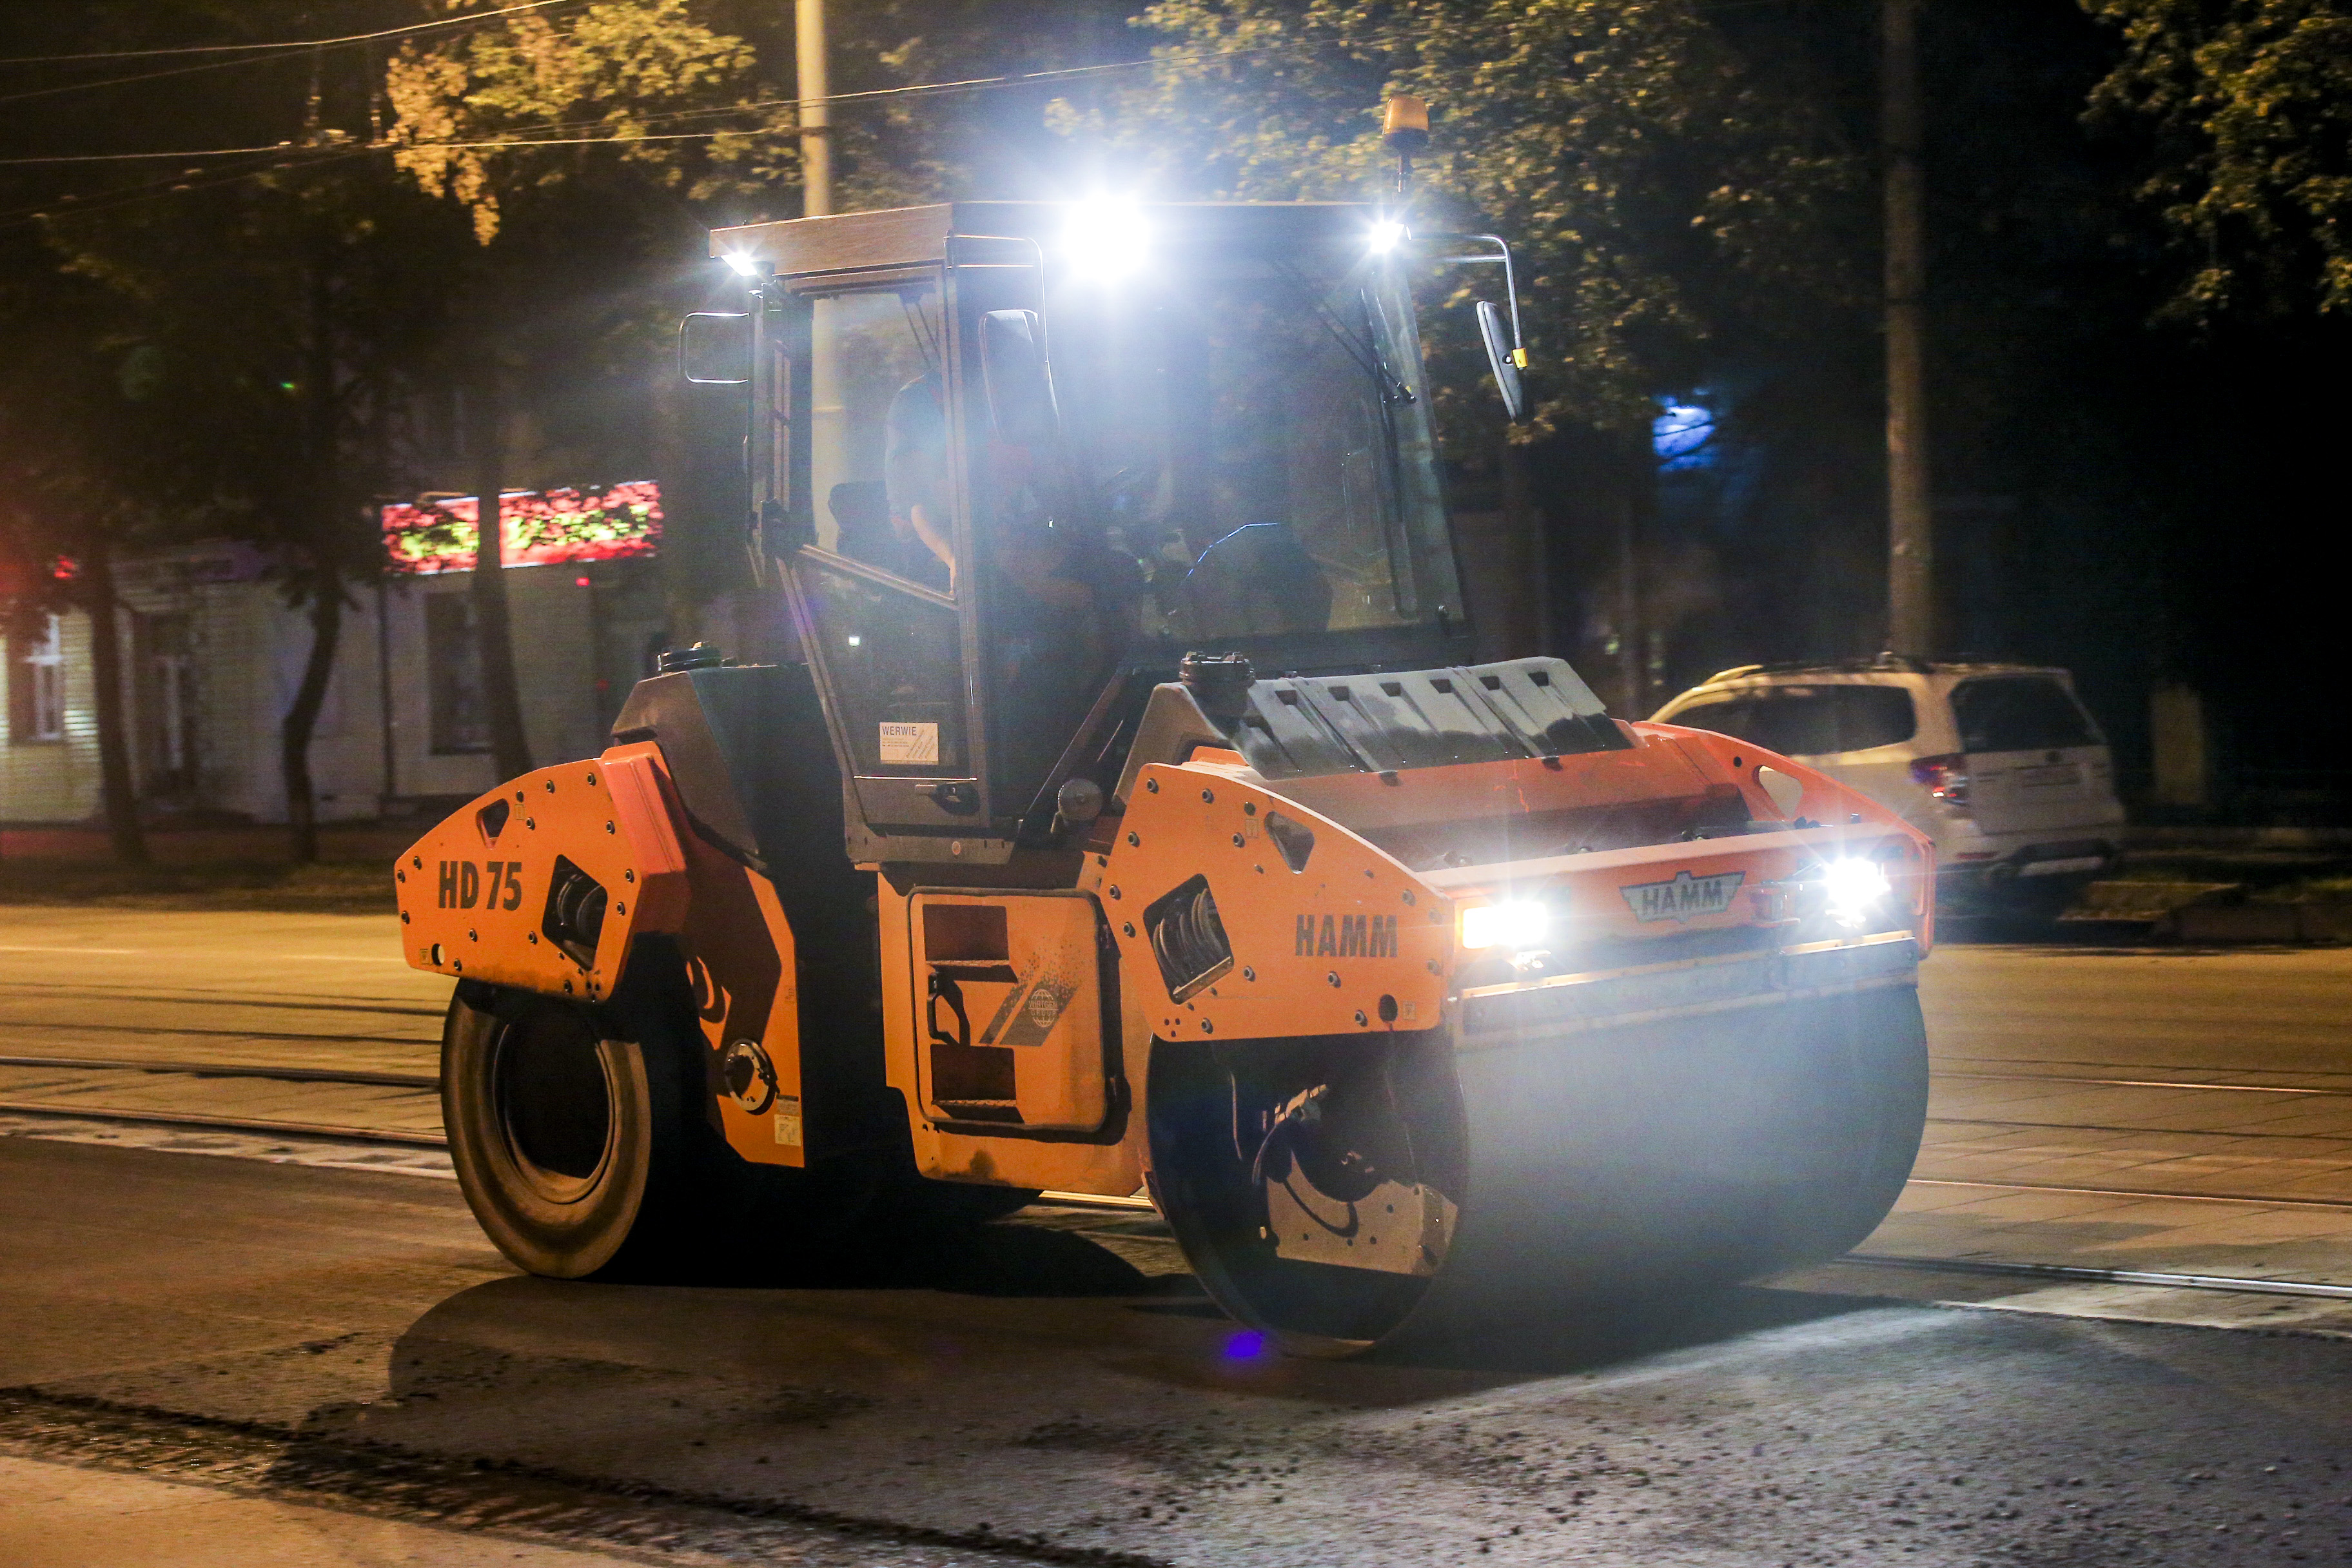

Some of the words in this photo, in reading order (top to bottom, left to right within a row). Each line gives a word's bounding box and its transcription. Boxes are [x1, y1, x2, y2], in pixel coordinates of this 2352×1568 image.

[882, 726, 917, 736] WERWIE
[438, 861, 479, 909] HD
[486, 861, 522, 911] 75
[1642, 879, 1723, 914] HAMM
[1295, 914, 1398, 957] HAMM
